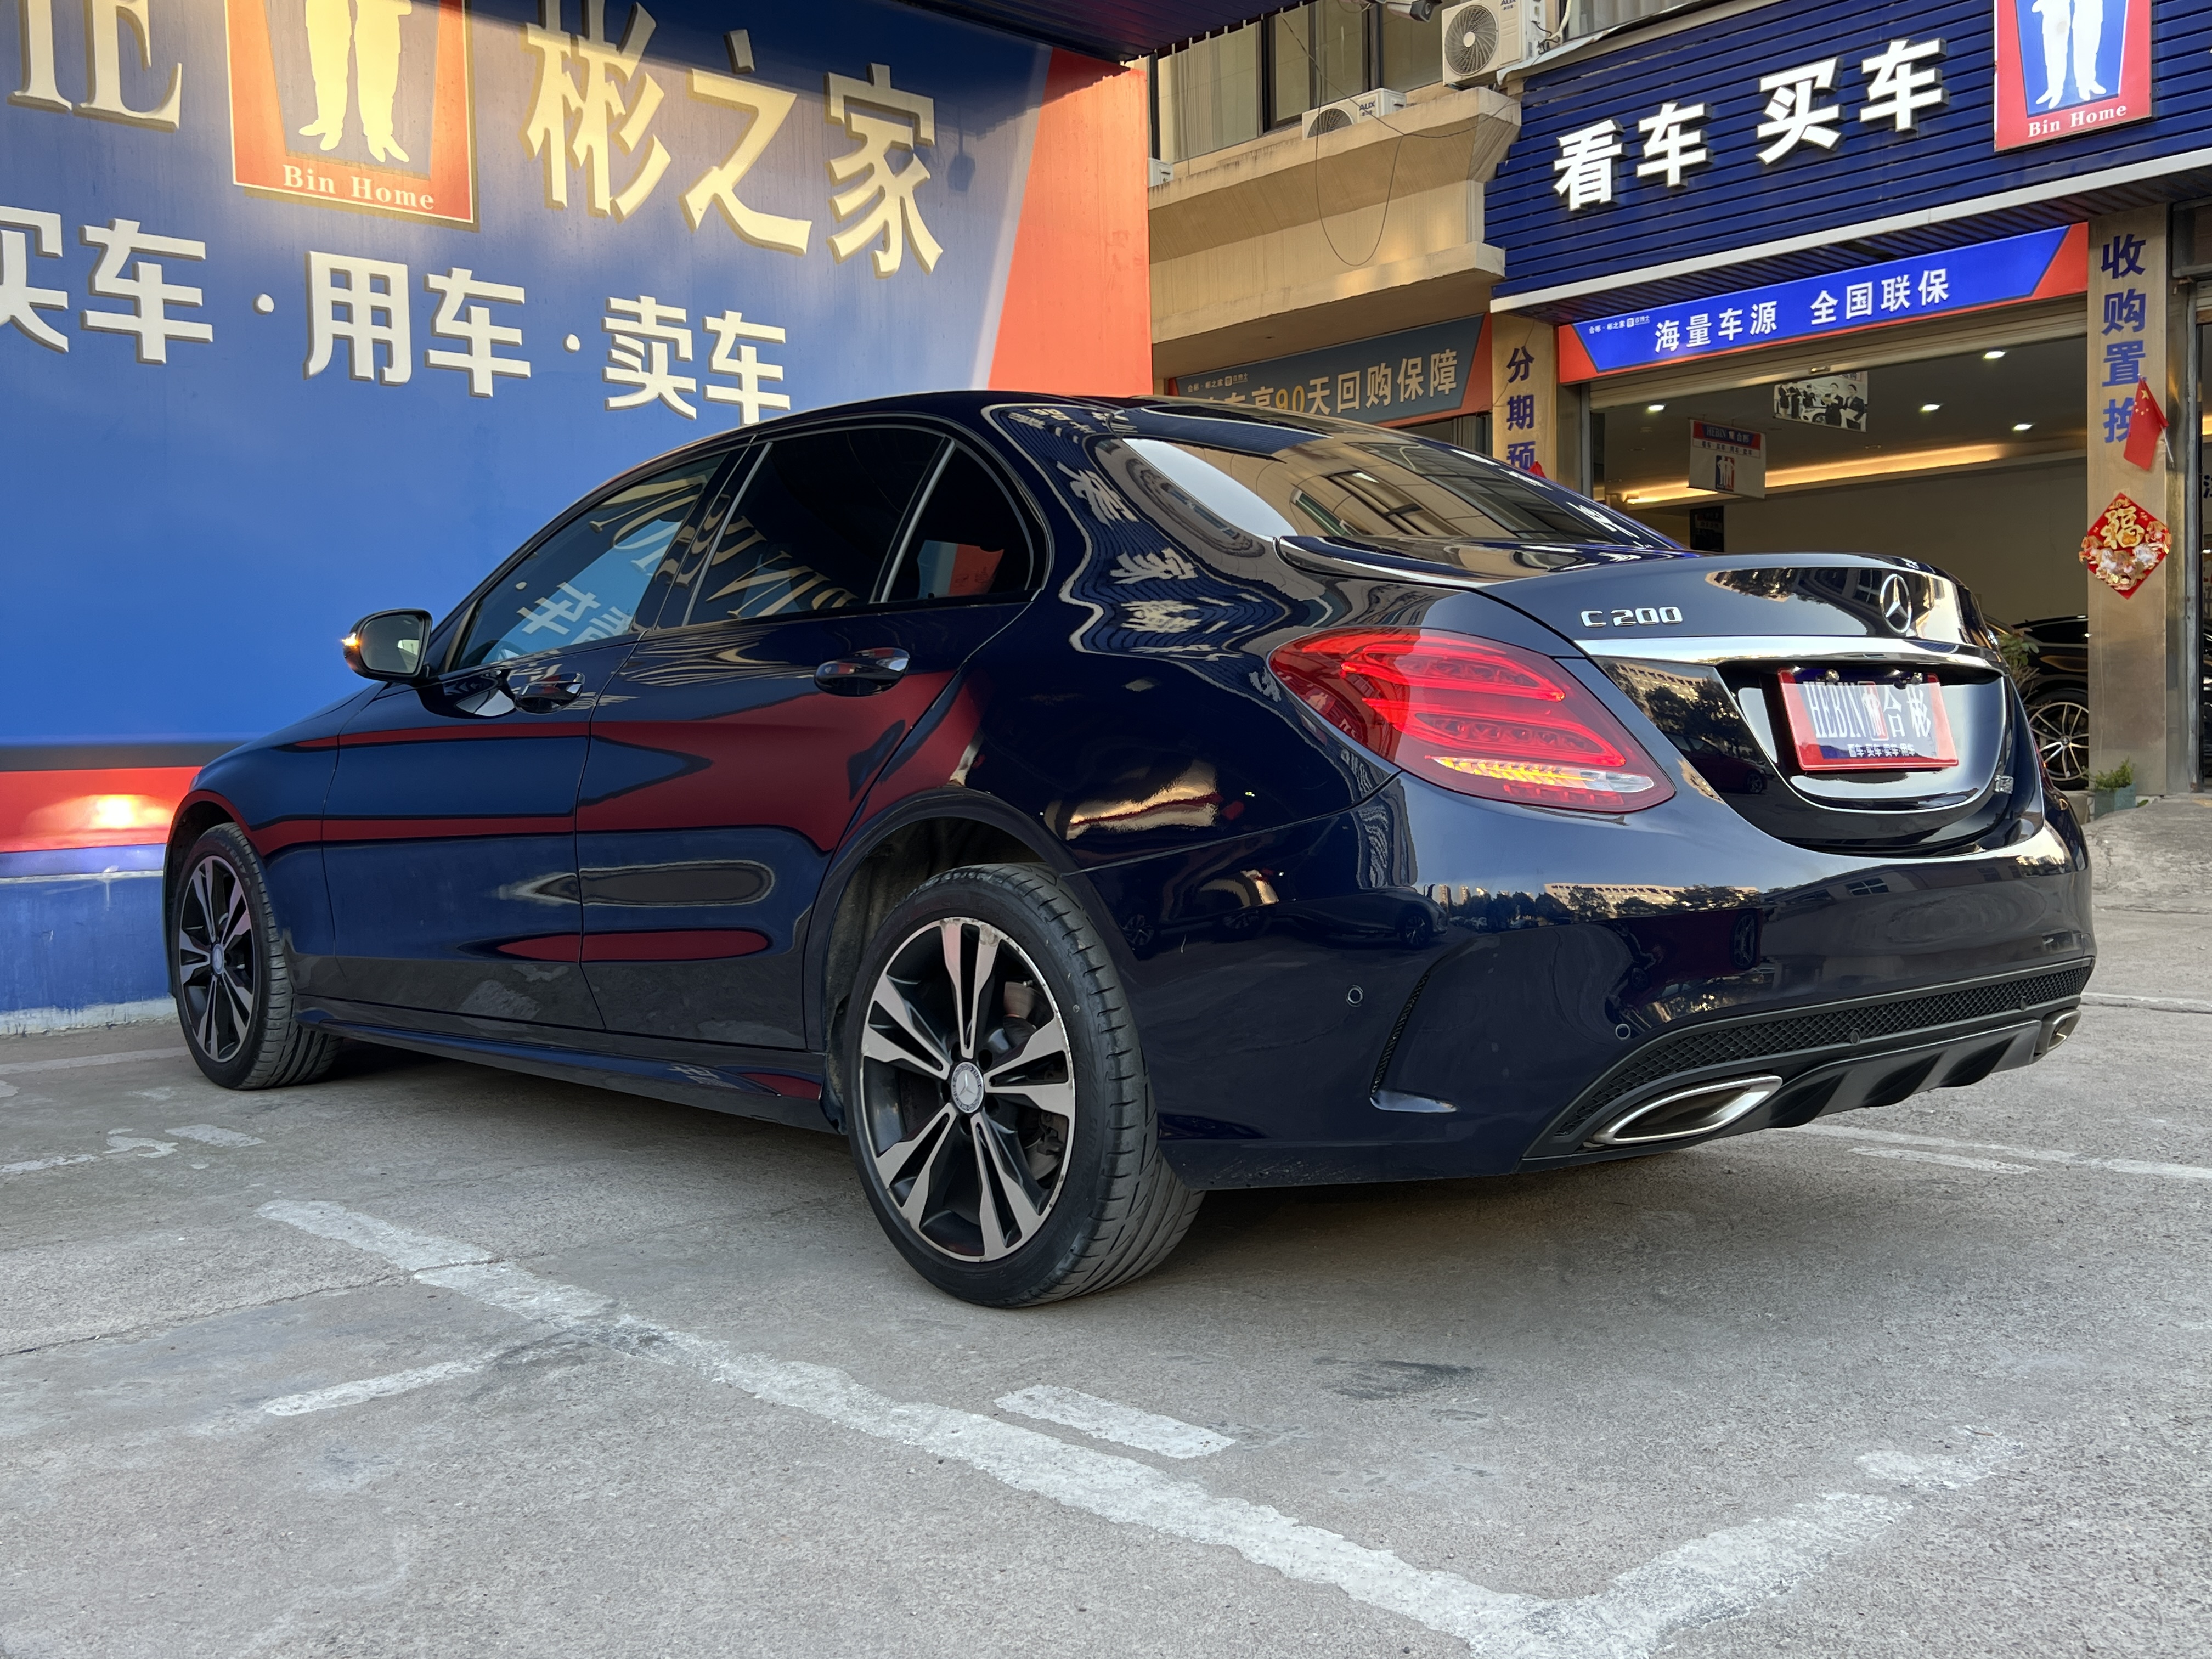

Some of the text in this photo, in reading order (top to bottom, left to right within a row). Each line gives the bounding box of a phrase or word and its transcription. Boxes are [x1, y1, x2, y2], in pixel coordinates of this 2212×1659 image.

[1359, 100, 1375, 111] AUX
[1554, 38, 1948, 212] 看车 买车
[2028, 105, 2128, 138] Bin Home
[524, 0, 944, 277] 彬之家
[283, 164, 435, 210] Bin Home
[1655, 267, 1950, 353] 海量车源 全国联保
[1706, 426, 1727, 439] HEBIN
[2100, 505, 2145, 550] 福
[1581, 607, 1683, 628] C 200
[1803, 681, 1932, 738] HEBIN 合彬
